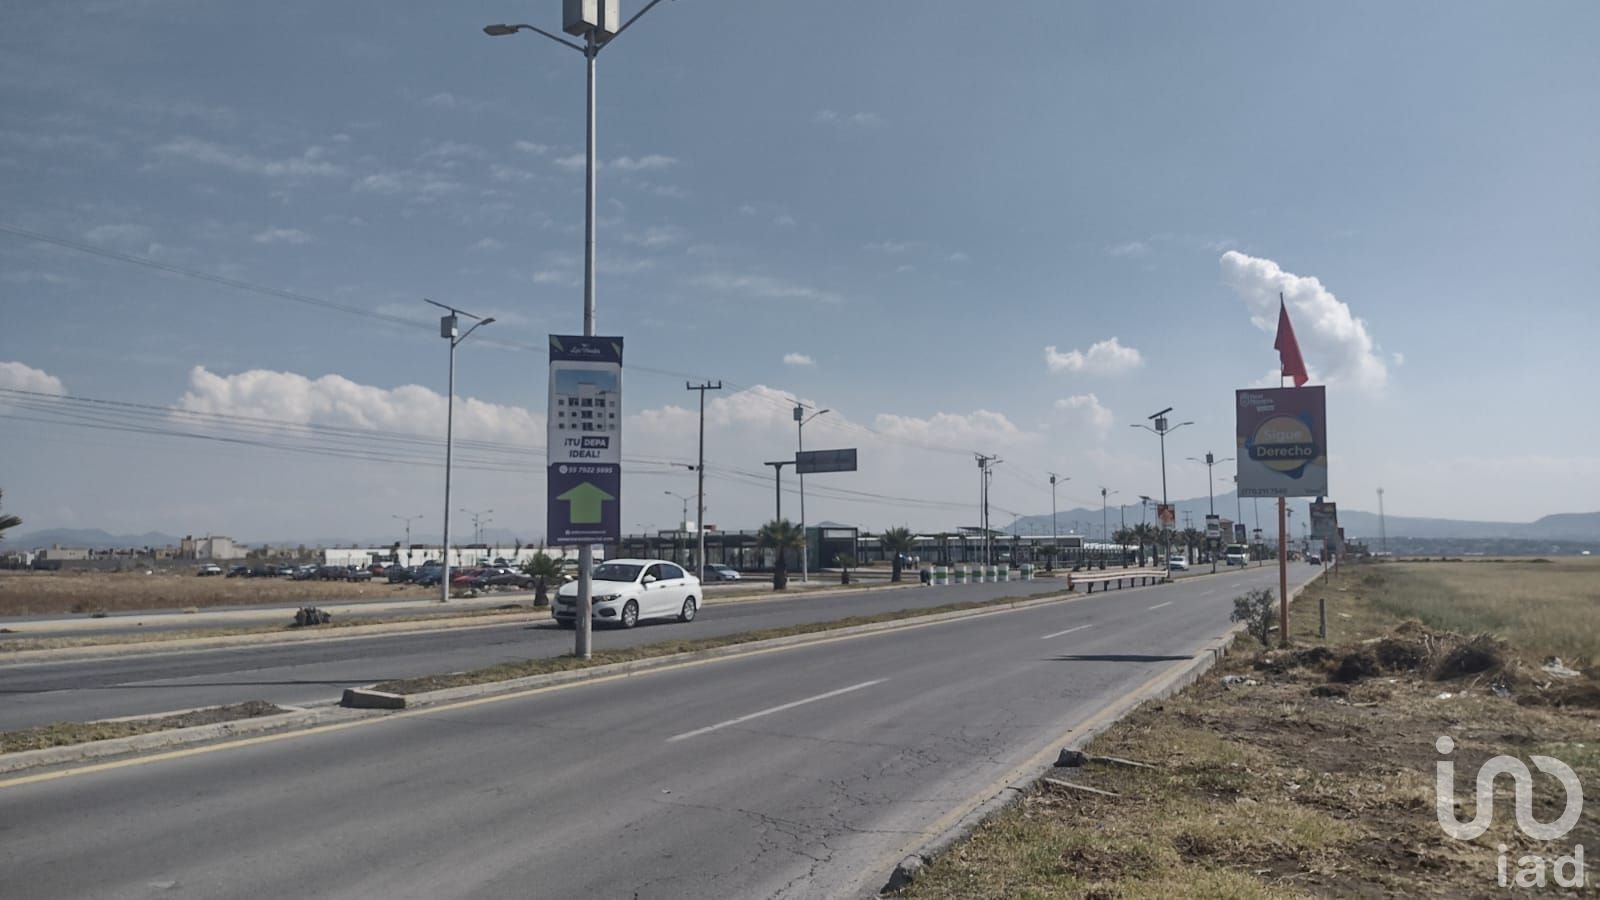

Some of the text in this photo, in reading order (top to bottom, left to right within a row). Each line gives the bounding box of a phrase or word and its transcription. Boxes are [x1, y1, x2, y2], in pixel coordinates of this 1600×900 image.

[1264, 431, 1301, 442] Sigue
[583, 438, 606, 447] DEPA
[569, 450, 600, 458] IDEAL!
[1256, 445, 1312, 457] Derecho
